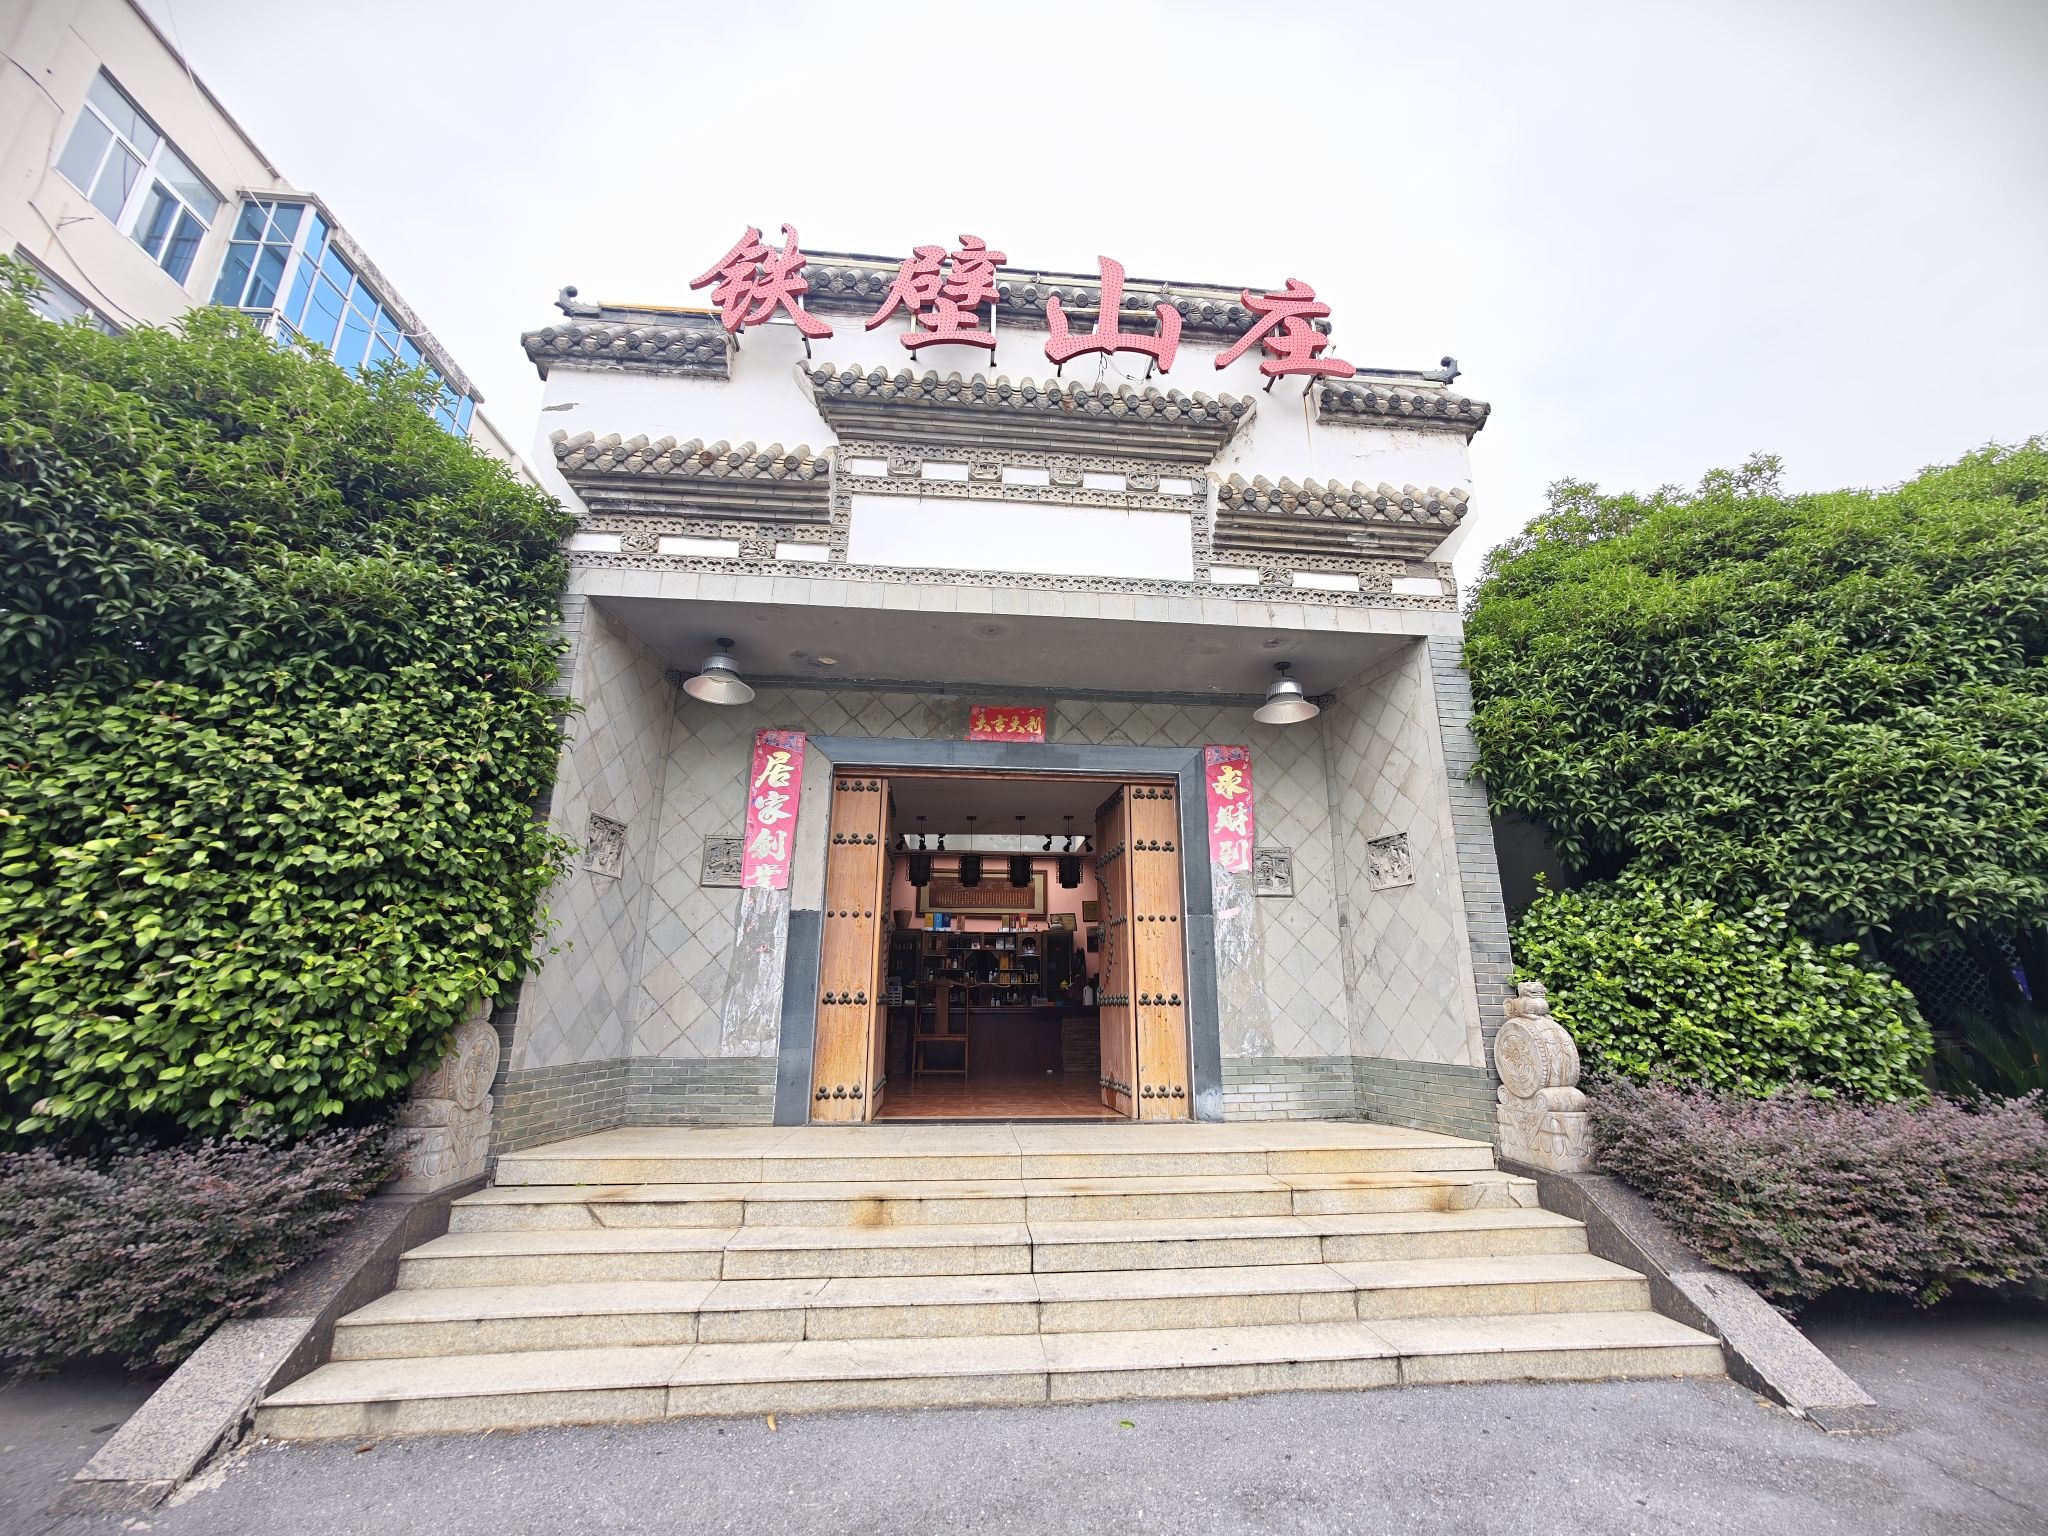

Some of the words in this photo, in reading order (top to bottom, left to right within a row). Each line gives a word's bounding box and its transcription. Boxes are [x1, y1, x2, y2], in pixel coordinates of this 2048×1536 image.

[689, 223, 1357, 379] 铁壁山庄
[973, 713, 1042, 735] 大吉大利
